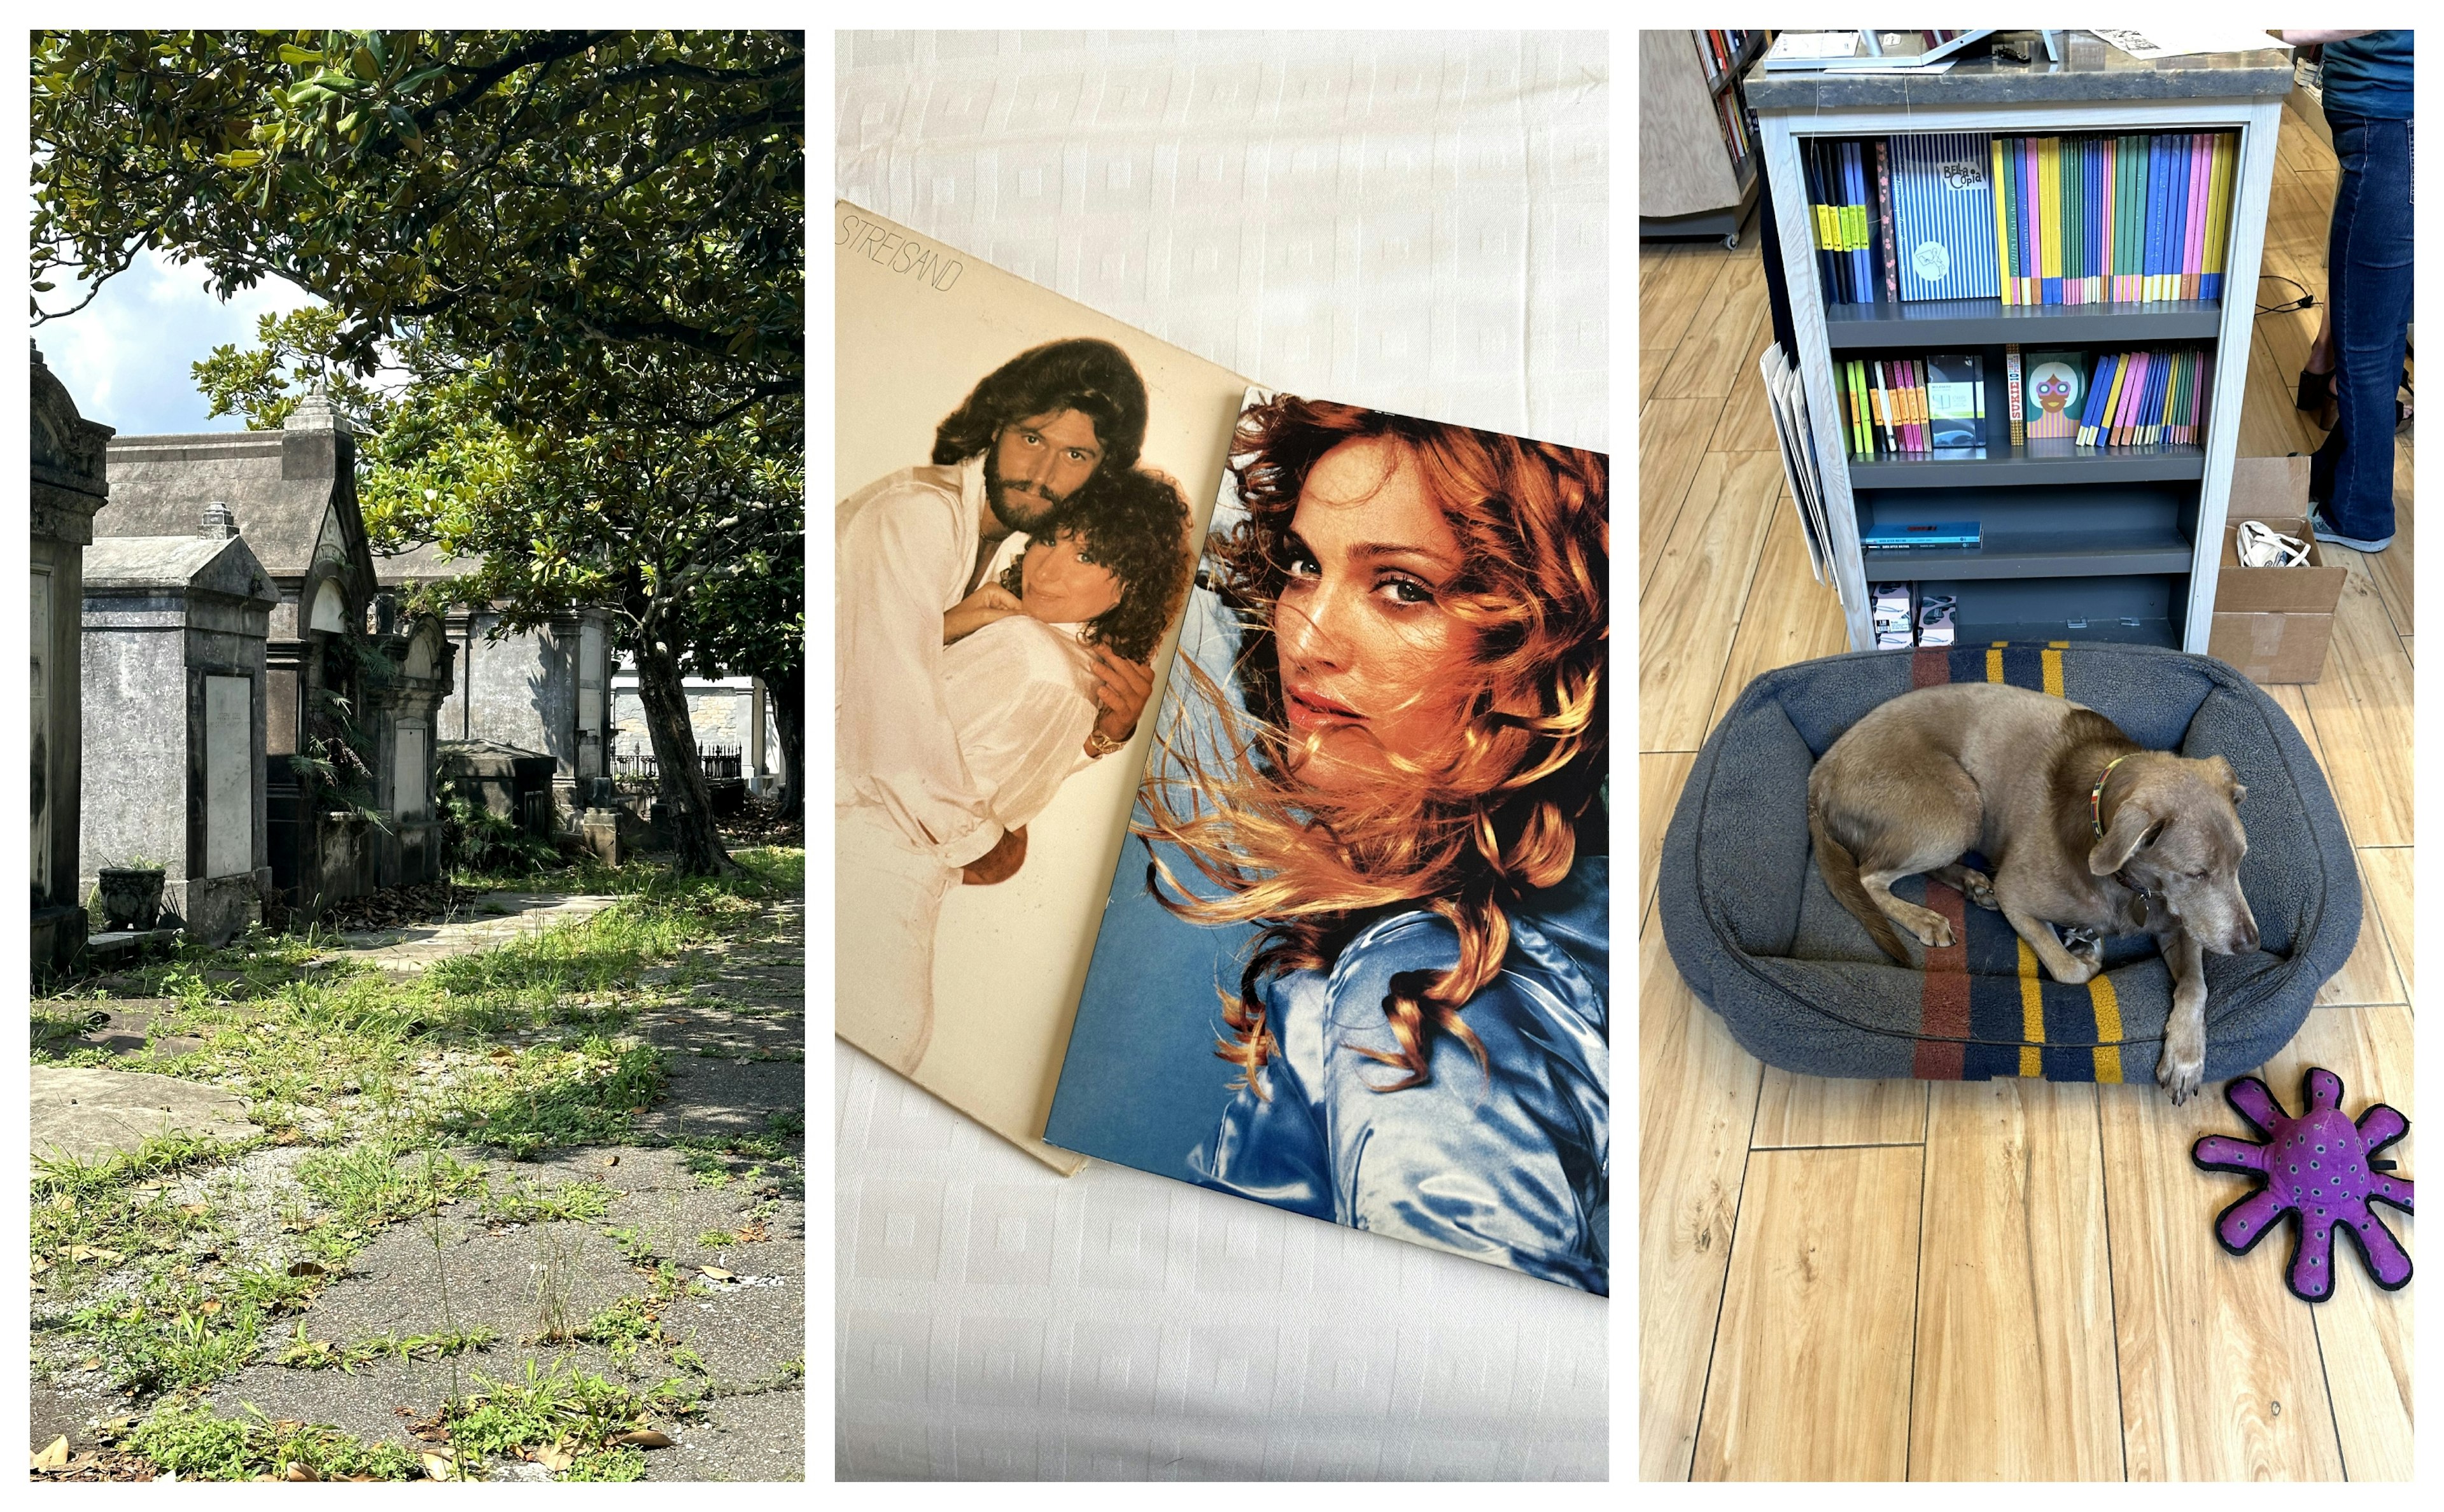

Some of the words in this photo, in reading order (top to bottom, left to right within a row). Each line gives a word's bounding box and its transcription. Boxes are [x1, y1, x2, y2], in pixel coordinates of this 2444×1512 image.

[1949, 169, 1982, 189] Copia
[835, 215, 964, 292] STREISAND
[2010, 381, 2021, 419] SUKIE
